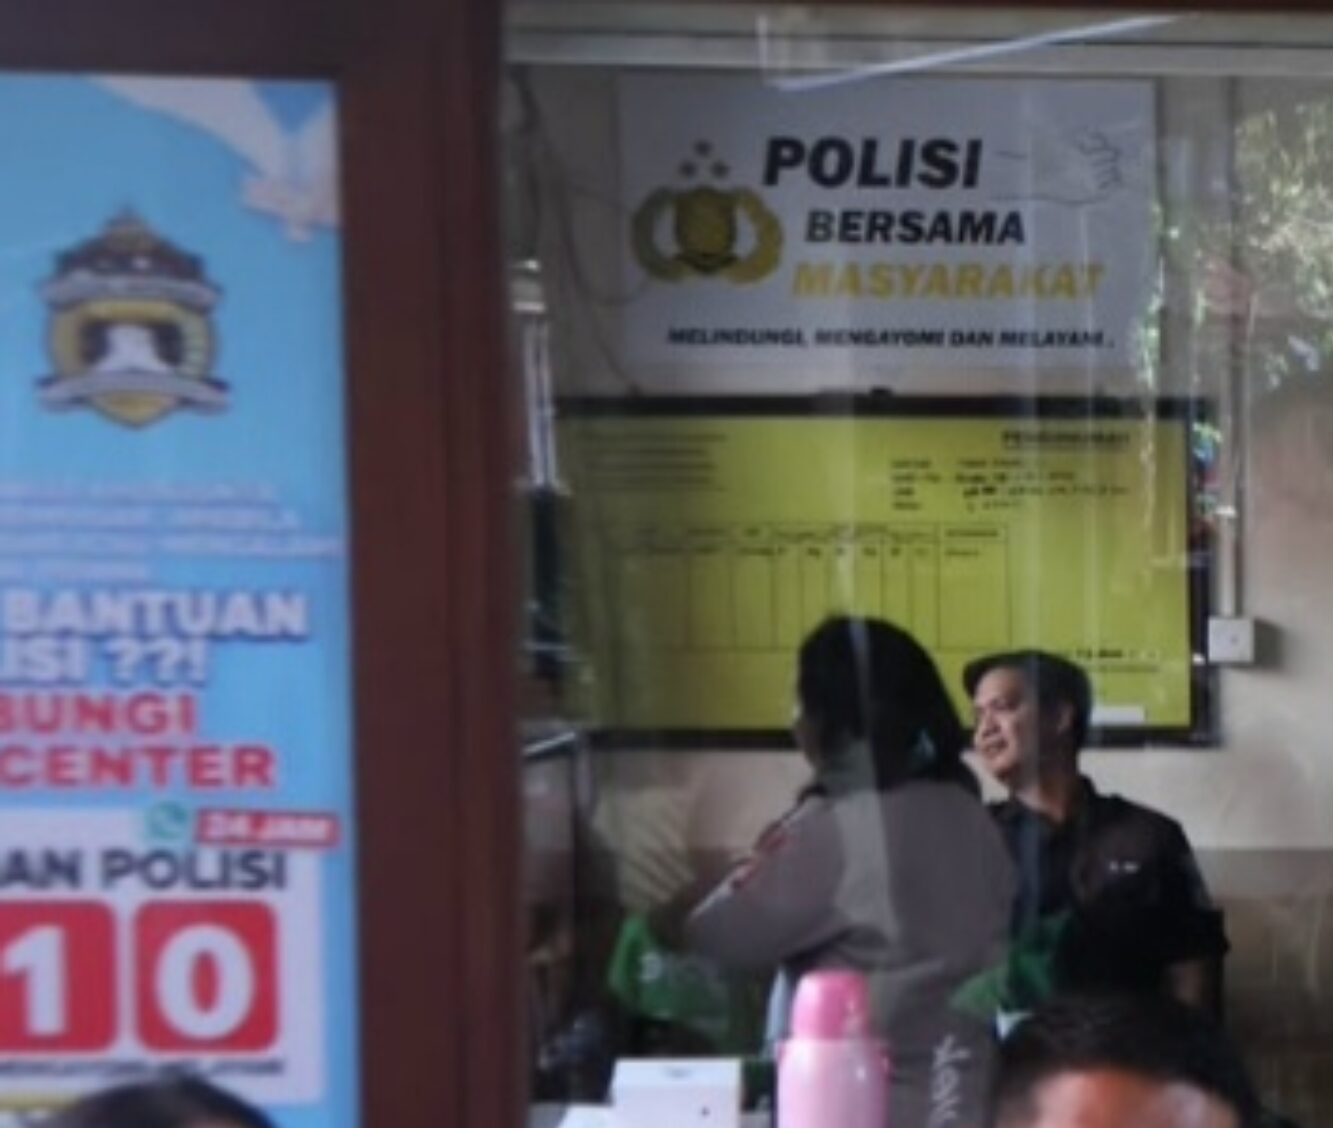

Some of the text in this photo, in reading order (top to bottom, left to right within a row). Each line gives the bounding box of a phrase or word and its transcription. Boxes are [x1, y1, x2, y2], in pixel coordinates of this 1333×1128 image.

[763, 137, 983, 189] POLISI
[804, 210, 1026, 245] BERSAMA
[793, 262, 1105, 299] MASYARAKAT
[814, 328, 946, 349] MENGAYOMI
[949, 329, 994, 349] DAN
[3, 588, 308, 634] BANTUAN
[0, 745, 275, 788] CENTER
[103, 851, 288, 890] POLISI
